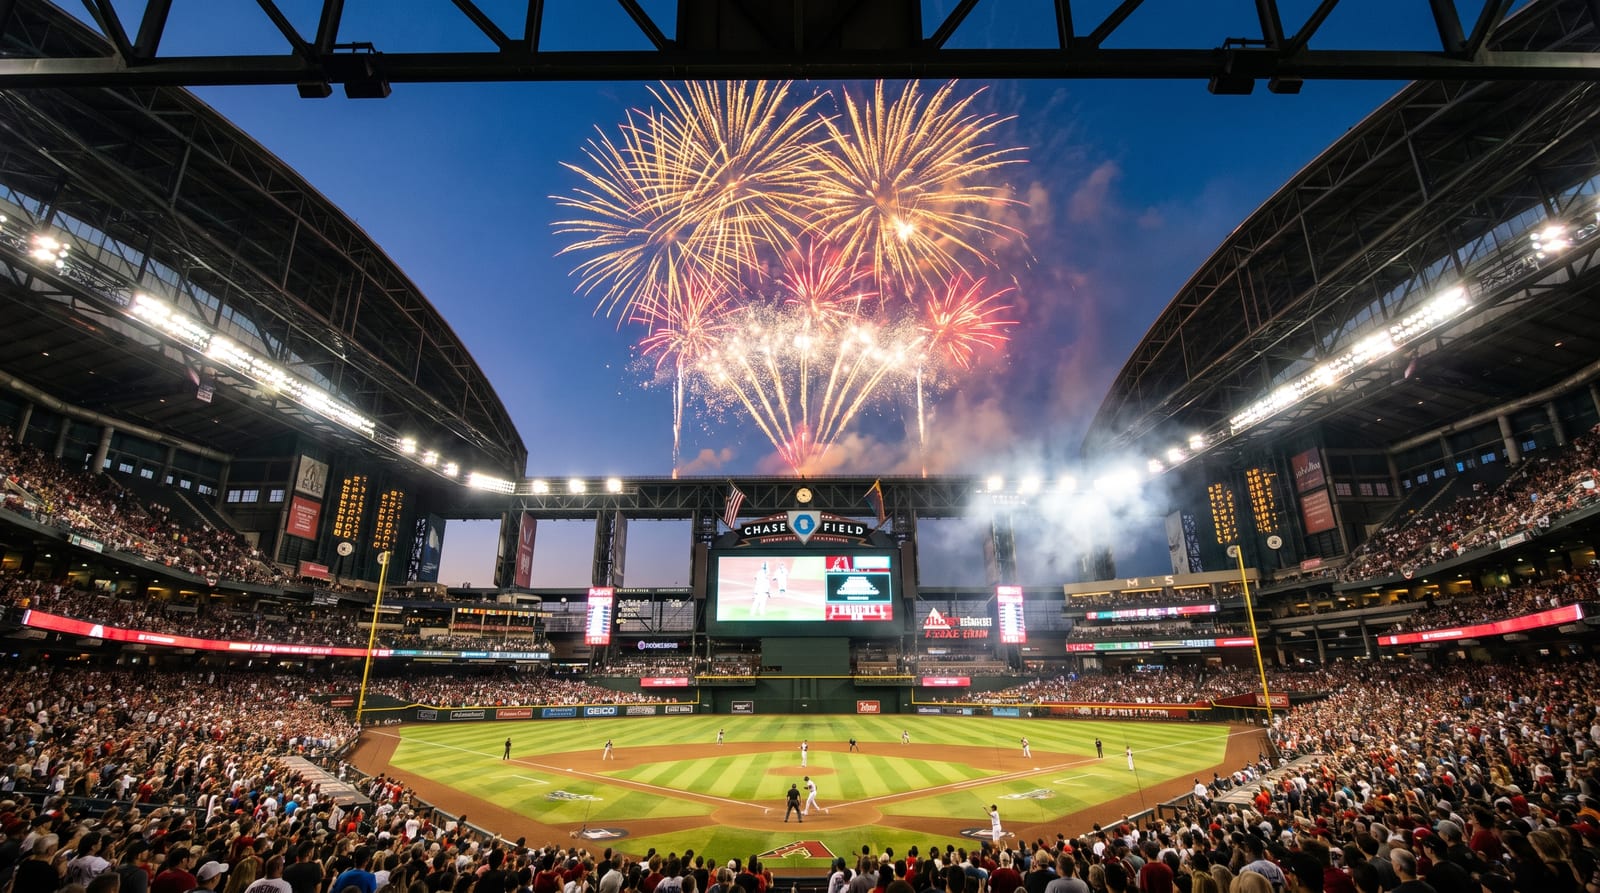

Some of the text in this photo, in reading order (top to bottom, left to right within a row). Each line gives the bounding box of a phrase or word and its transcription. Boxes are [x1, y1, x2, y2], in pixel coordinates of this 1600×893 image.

[744, 523, 864, 536] CHASE FIELD
[587, 707, 615, 715] GEICO
